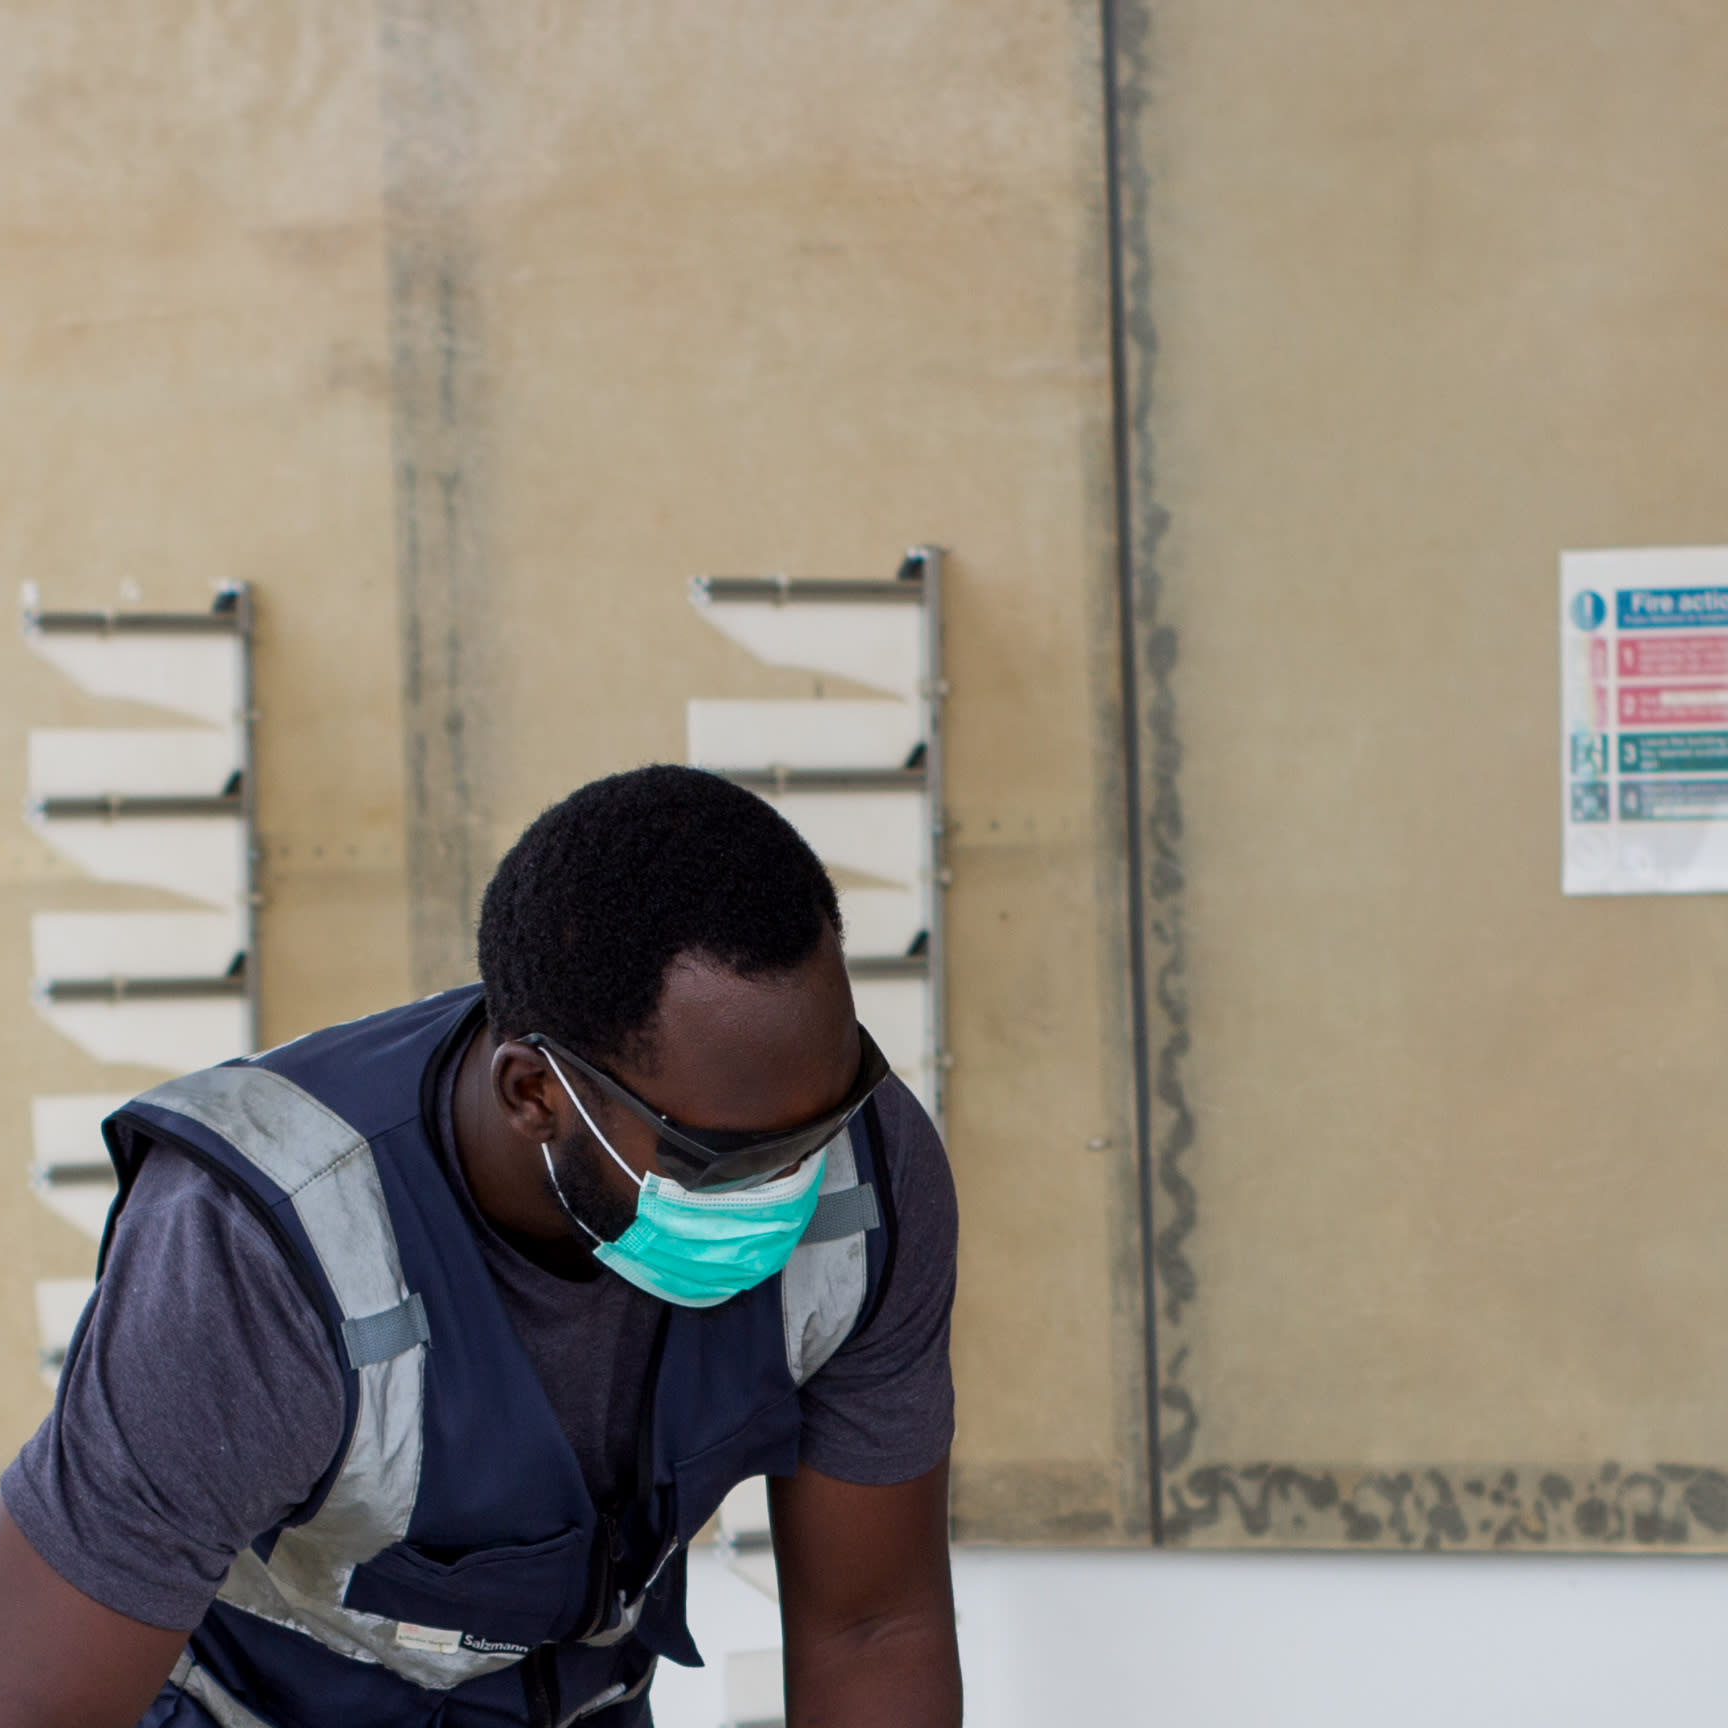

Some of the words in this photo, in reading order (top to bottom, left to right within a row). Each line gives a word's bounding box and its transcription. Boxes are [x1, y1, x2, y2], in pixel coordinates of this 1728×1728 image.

[1631, 592, 1674, 613] Fire
[1622, 742, 1637, 764] 3
[462, 1633, 529, 1654] Salzmann
